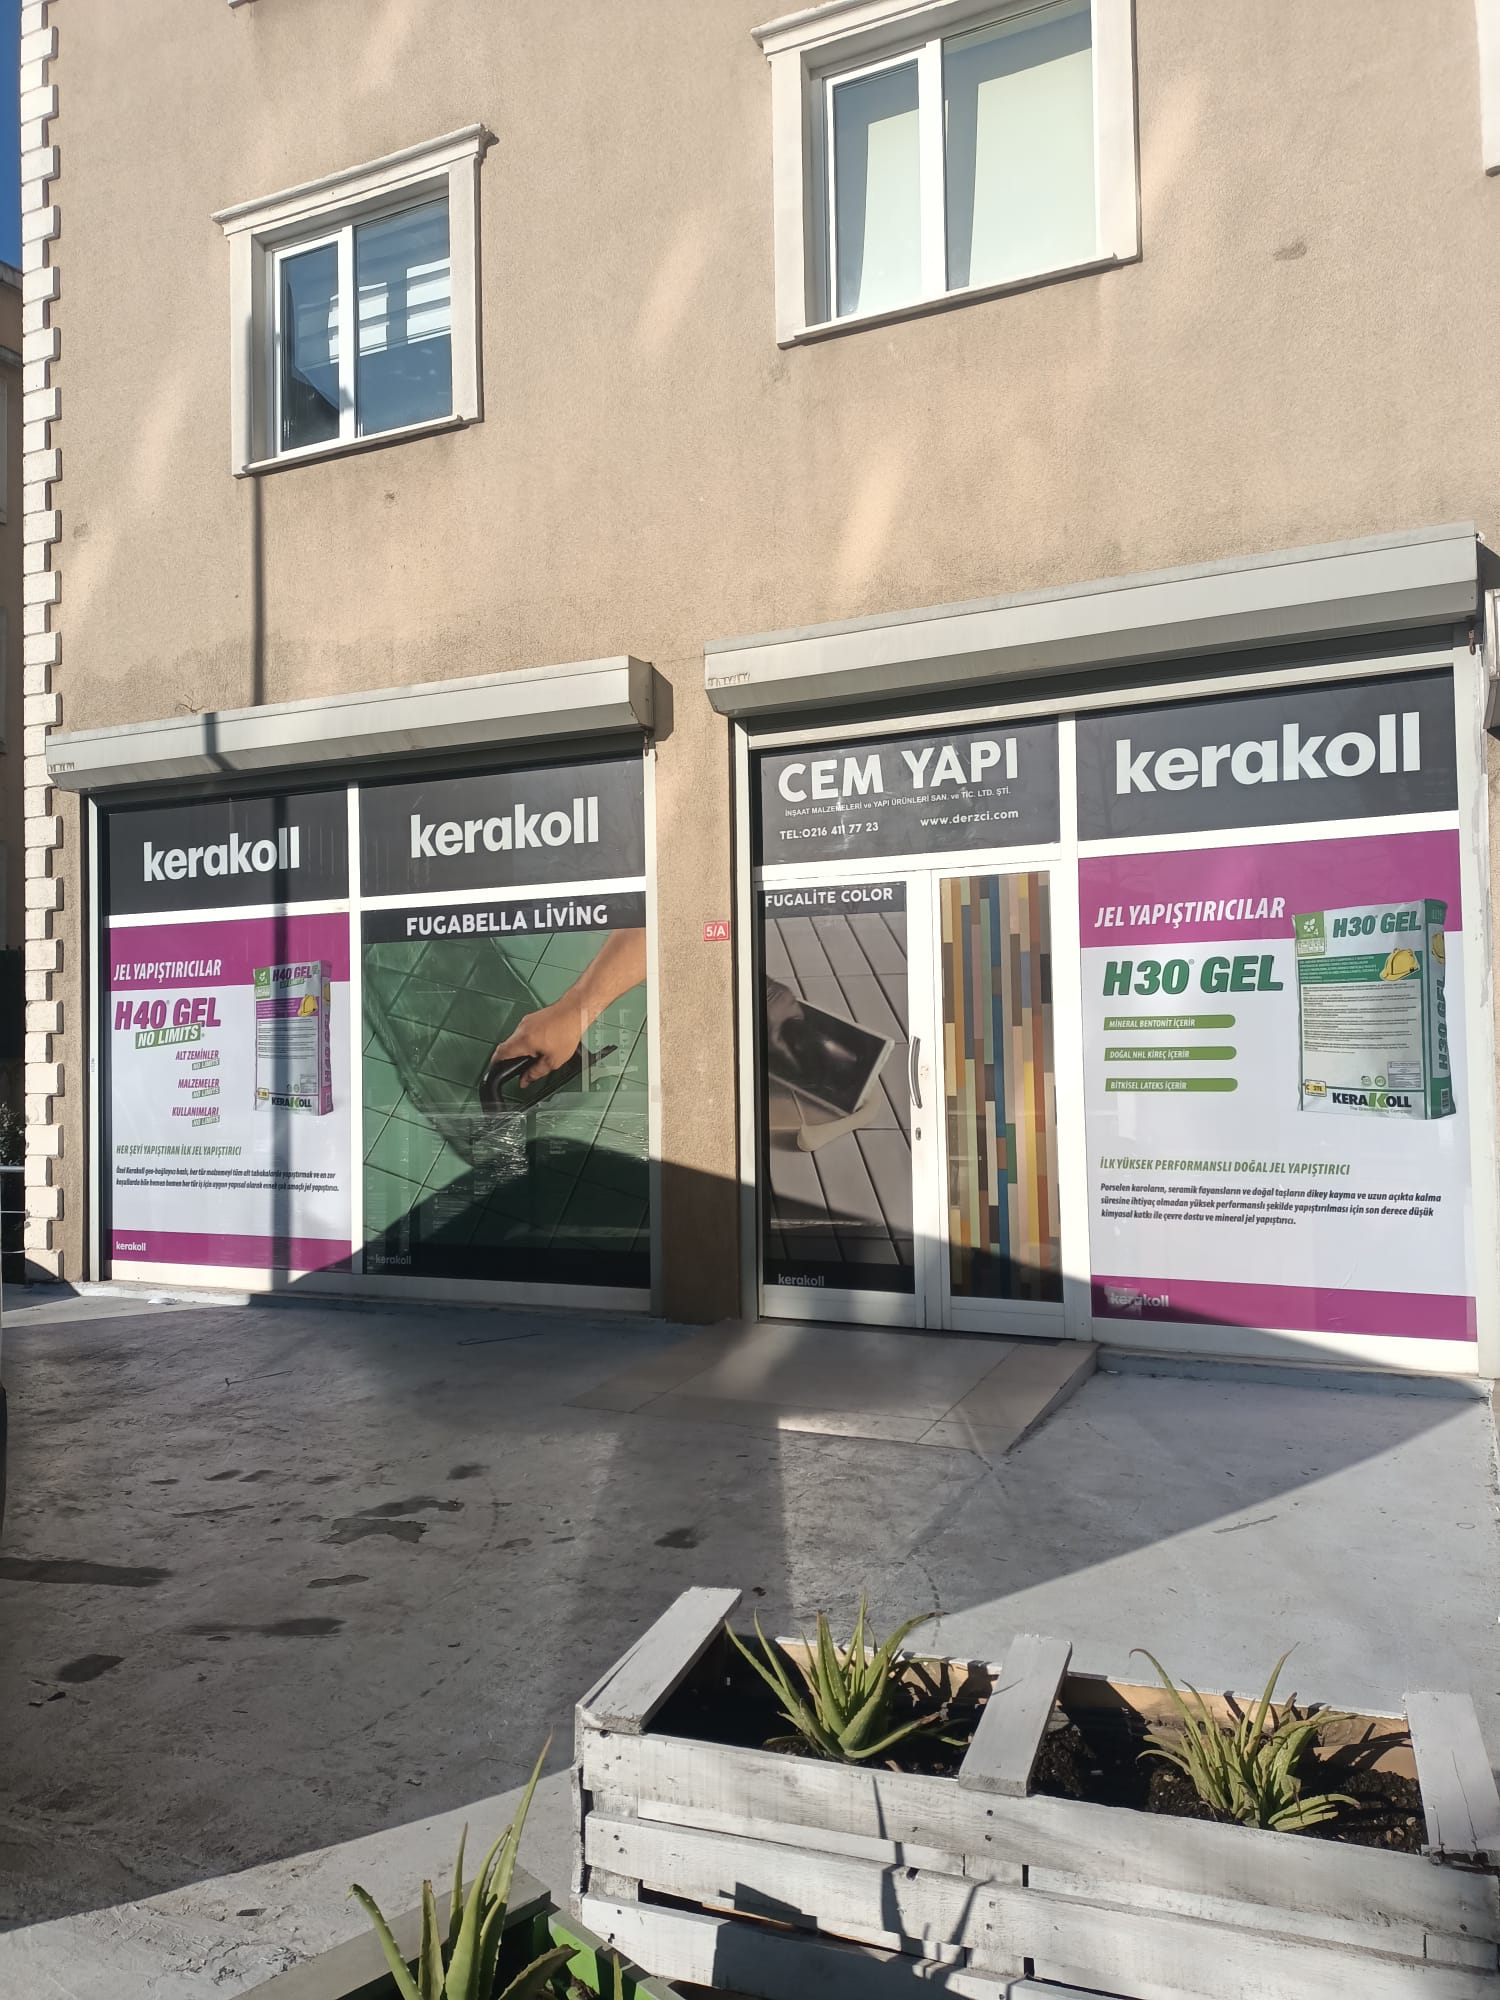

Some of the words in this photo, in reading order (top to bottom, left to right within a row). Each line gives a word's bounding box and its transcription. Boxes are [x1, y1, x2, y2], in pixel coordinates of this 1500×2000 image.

[1115, 712, 1421, 796] kerakoll
[778, 755, 884, 802] CEM
[901, 738, 1018, 789] YAPI
[785, 807, 810, 817] İNŞAAT
[811, 802, 862, 814] MALZEMELERİ
[873, 800, 890, 808] YAPI
[891, 796, 930, 806] ÜRÜNLERİ
[978, 789, 995, 798] LTD.
[996, 786, 1011, 797] ŞTİ.
[410, 796, 599, 858] kerakoll
[920, 810, 1019, 827] www.derzci.com
[831, 824, 846, 836] 411
[849, 823, 862, 834] 77
[866, 822, 879, 833] 23
[143, 826, 300, 882] kerakoll
[766, 889, 837, 908] FUGALİTE
[841, 887, 894, 903] COLOR
[406, 910, 527, 937] FUGABELLA
[534, 901, 608, 929] LİVİNG
[1094, 907, 1124, 928] JEL
[1129, 897, 1286, 929] YAPIŞTIRICILAR
[706, 924, 727, 938] 5/A
[1332, 915, 1376, 938] H30
[1380, 911, 1421, 934] GEL
[114, 964, 131, 981] JEL
[133, 959, 222, 983] YAPIŞTIRICILAR
[272, 968, 292, 982] H40
[294, 965, 313, 979] GEL
[1102, 959, 1190, 996] H30
[1200, 955, 1285, 994] GEL
[114, 999, 167, 1030] H40
[172, 997, 221, 1028] GEL
[1109, 1018, 1138, 1028] MİNERAL
[1139, 1017, 1173, 1028] BENTONİT
[137, 1032, 155, 1048] NO
[158, 1025, 199, 1045] LIMITS
[176, 1050, 187, 1060] ALT
[187, 1048, 219, 1060] ZEMİNLER
[1110, 1050, 1131, 1059] DOĞAL
[1132, 1051, 1147, 1059] NHL
[178, 1078, 220, 1089] MALZEMELER
[1110, 1081, 1138, 1090] BİTKİSEL
[1140, 1081, 1164, 1090] LATEKS
[271, 1096, 312, 1108] KERAKOLL
[1332, 1092, 1412, 1109] KERAKOLL
[172, 1106, 219, 1117] KULLANIMLARI
[117, 1145, 129, 1154] HER
[192, 1146, 202, 1156] JEL
[203, 1146, 242, 1158] YAPIŞTIRICI
[1099, 1156, 1116, 1169] İLK
[1117, 1157, 1153, 1170] YÜKSEK
[1155, 1159, 1232, 1172] PERFORMANSLI
[1233, 1160, 1268, 1173] DOĞAL
[1268, 1163, 1286, 1174] JEL
[1288, 1162, 1351, 1178] YAPIŞTIRICI
[1100, 1182, 1131, 1192] Porselen
[1168, 1185, 1198, 1195] seramik
[1198, 1186, 1241, 1197] fayansların
[1252, 1188, 1275, 1198] doğal
[1275, 1189, 1305, 1199] taşların
[1306, 1189, 1329, 1200] dikey
[1329, 1190, 1356, 1201] kayma
[1367, 1193, 1388, 1201] uzun
[1388, 1192, 1414, 1203] açıkta
[1415, 1193, 1442, 1202] kalma
[1100, 1196, 1131, 1206] süresine
[1131, 1197, 1156, 1208] ihtiyaç
[1156, 1198, 1189, 1207] olmadan
[1189, 1199, 1215, 1209] yüksek
[1215, 1200, 1265, 1211] performanslı
[1266, 1202, 1293, 1212] şekilde
[1349, 1205, 1364, 1216] için
[1365, 1207, 1380, 1215] son
[1380, 1206, 1408, 1216] derece
[1408, 1207, 1434, 1218] düşük
[1101, 1209, 1133, 1220] kimyasal
[1133, 1210, 1153, 1219] katkı
[1153, 1211, 1163, 1220] ile
[1163, 1213, 1183, 1221] çevre
[1183, 1212, 1204, 1221] dostu
[1214, 1213, 1245, 1223] mineral
[1244, 1214, 1256, 1224] jel
[115, 1240, 147, 1252] kerakoll
[375, 1253, 412, 1265] kerakoll
[778, 1273, 825, 1287] kerakoll
[1110, 1293, 1169, 1308] kerakoll
